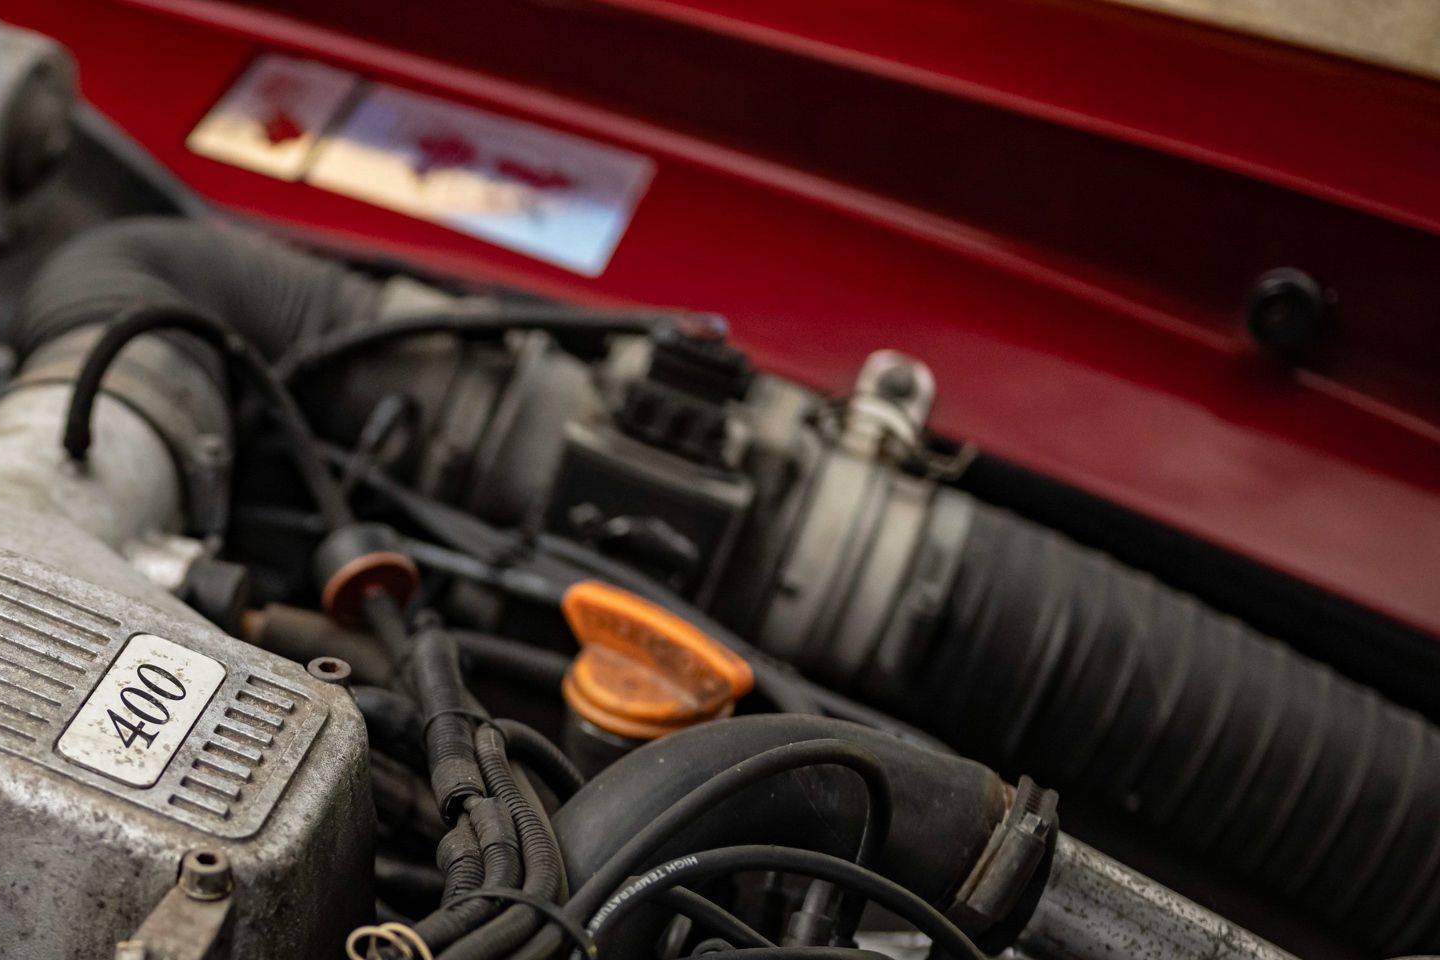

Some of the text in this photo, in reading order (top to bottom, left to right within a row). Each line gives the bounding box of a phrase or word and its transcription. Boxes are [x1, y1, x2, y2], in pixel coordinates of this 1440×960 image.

[107, 663, 187, 749] 400
[665, 856, 698, 874] HIGH
[588, 869, 667, 930] TEMPERATURE
